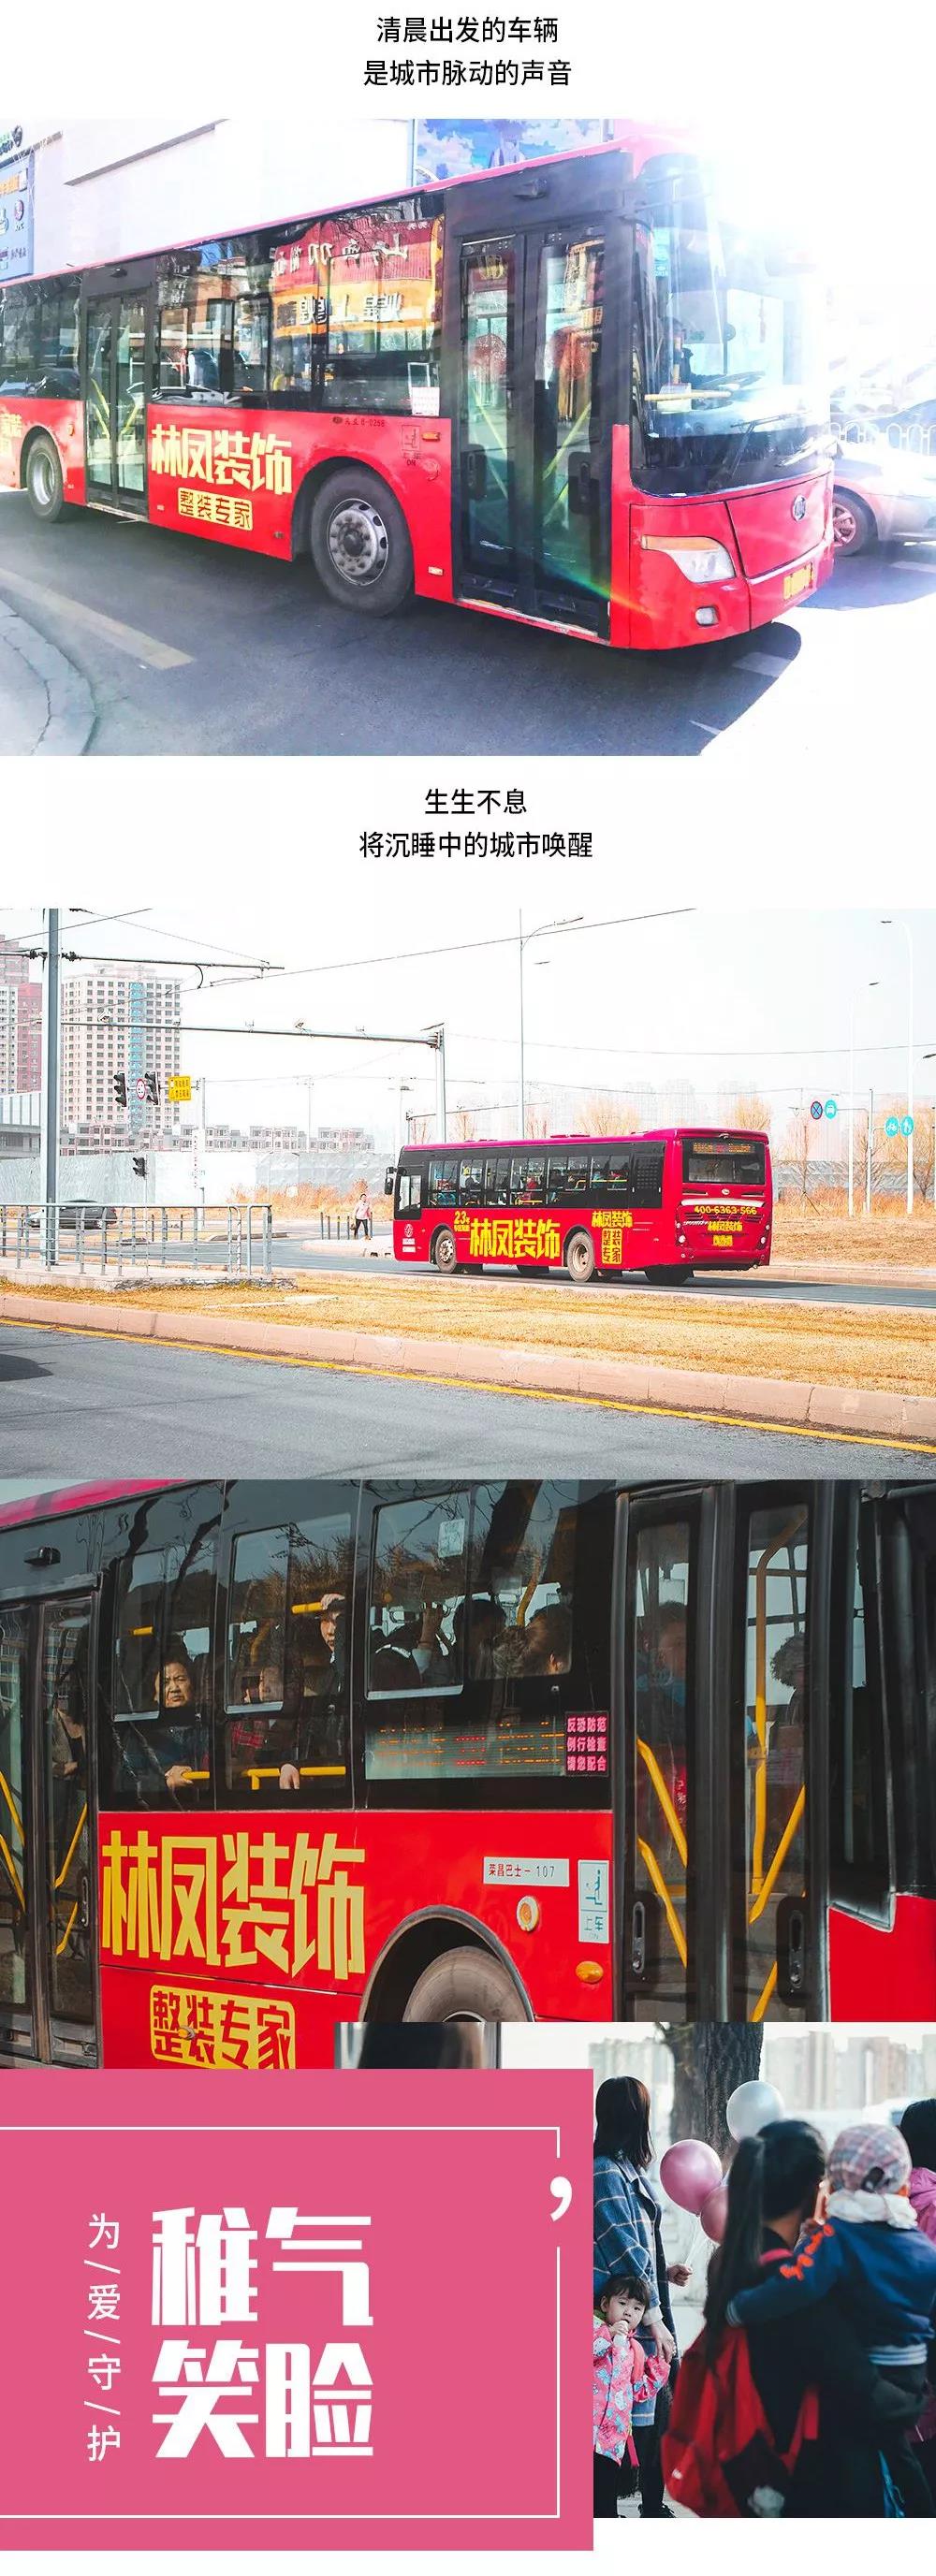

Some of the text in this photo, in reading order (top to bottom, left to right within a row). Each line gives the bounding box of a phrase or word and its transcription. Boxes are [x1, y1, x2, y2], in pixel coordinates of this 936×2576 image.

[151, 423, 293, 495] 林凤装饰
[179, 489, 251, 530] 整装专家
[592, 1210, 634, 1228] 林凤装饰
[694, 1205, 757, 1215] 400-6363-566
[469, 1217, 561, 1259] 林凤装饰
[567, 1716, 607, 1733] 反恐防范
[567, 1736, 607, 1753] 例行检查
[567, 1754, 607, 1772] 请您配合
[102, 1829, 366, 1981] 林凤装饰
[584, 1915, 604, 1931] 上车
[153, 1989, 292, 2069] 整装专家
